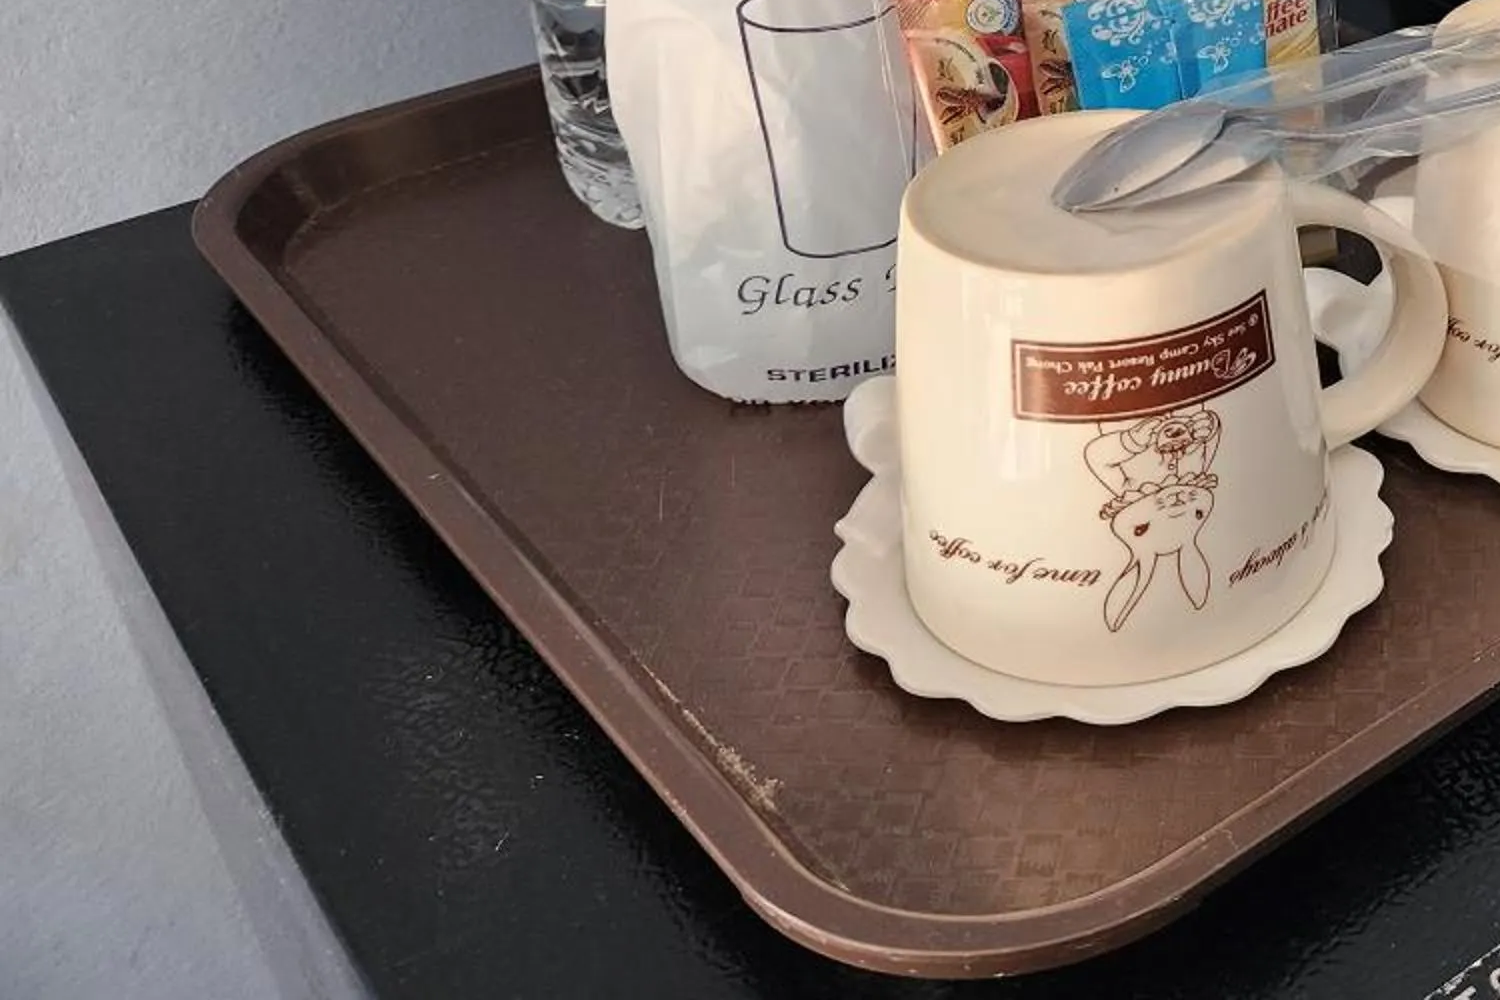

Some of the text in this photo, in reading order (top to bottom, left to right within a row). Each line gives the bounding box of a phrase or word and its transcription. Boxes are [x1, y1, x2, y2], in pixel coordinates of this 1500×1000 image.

[737, 273, 863, 316] Glass
[1159, 345, 1200, 361] Camp
[1203, 334, 1226, 348] Sky
[1063, 374, 1142, 401] coffee
[929, 529, 981, 563] coffee
[988, 557, 1045, 584] for
[1228, 532, 1297, 588] always
[1033, 567, 1102, 587] time
